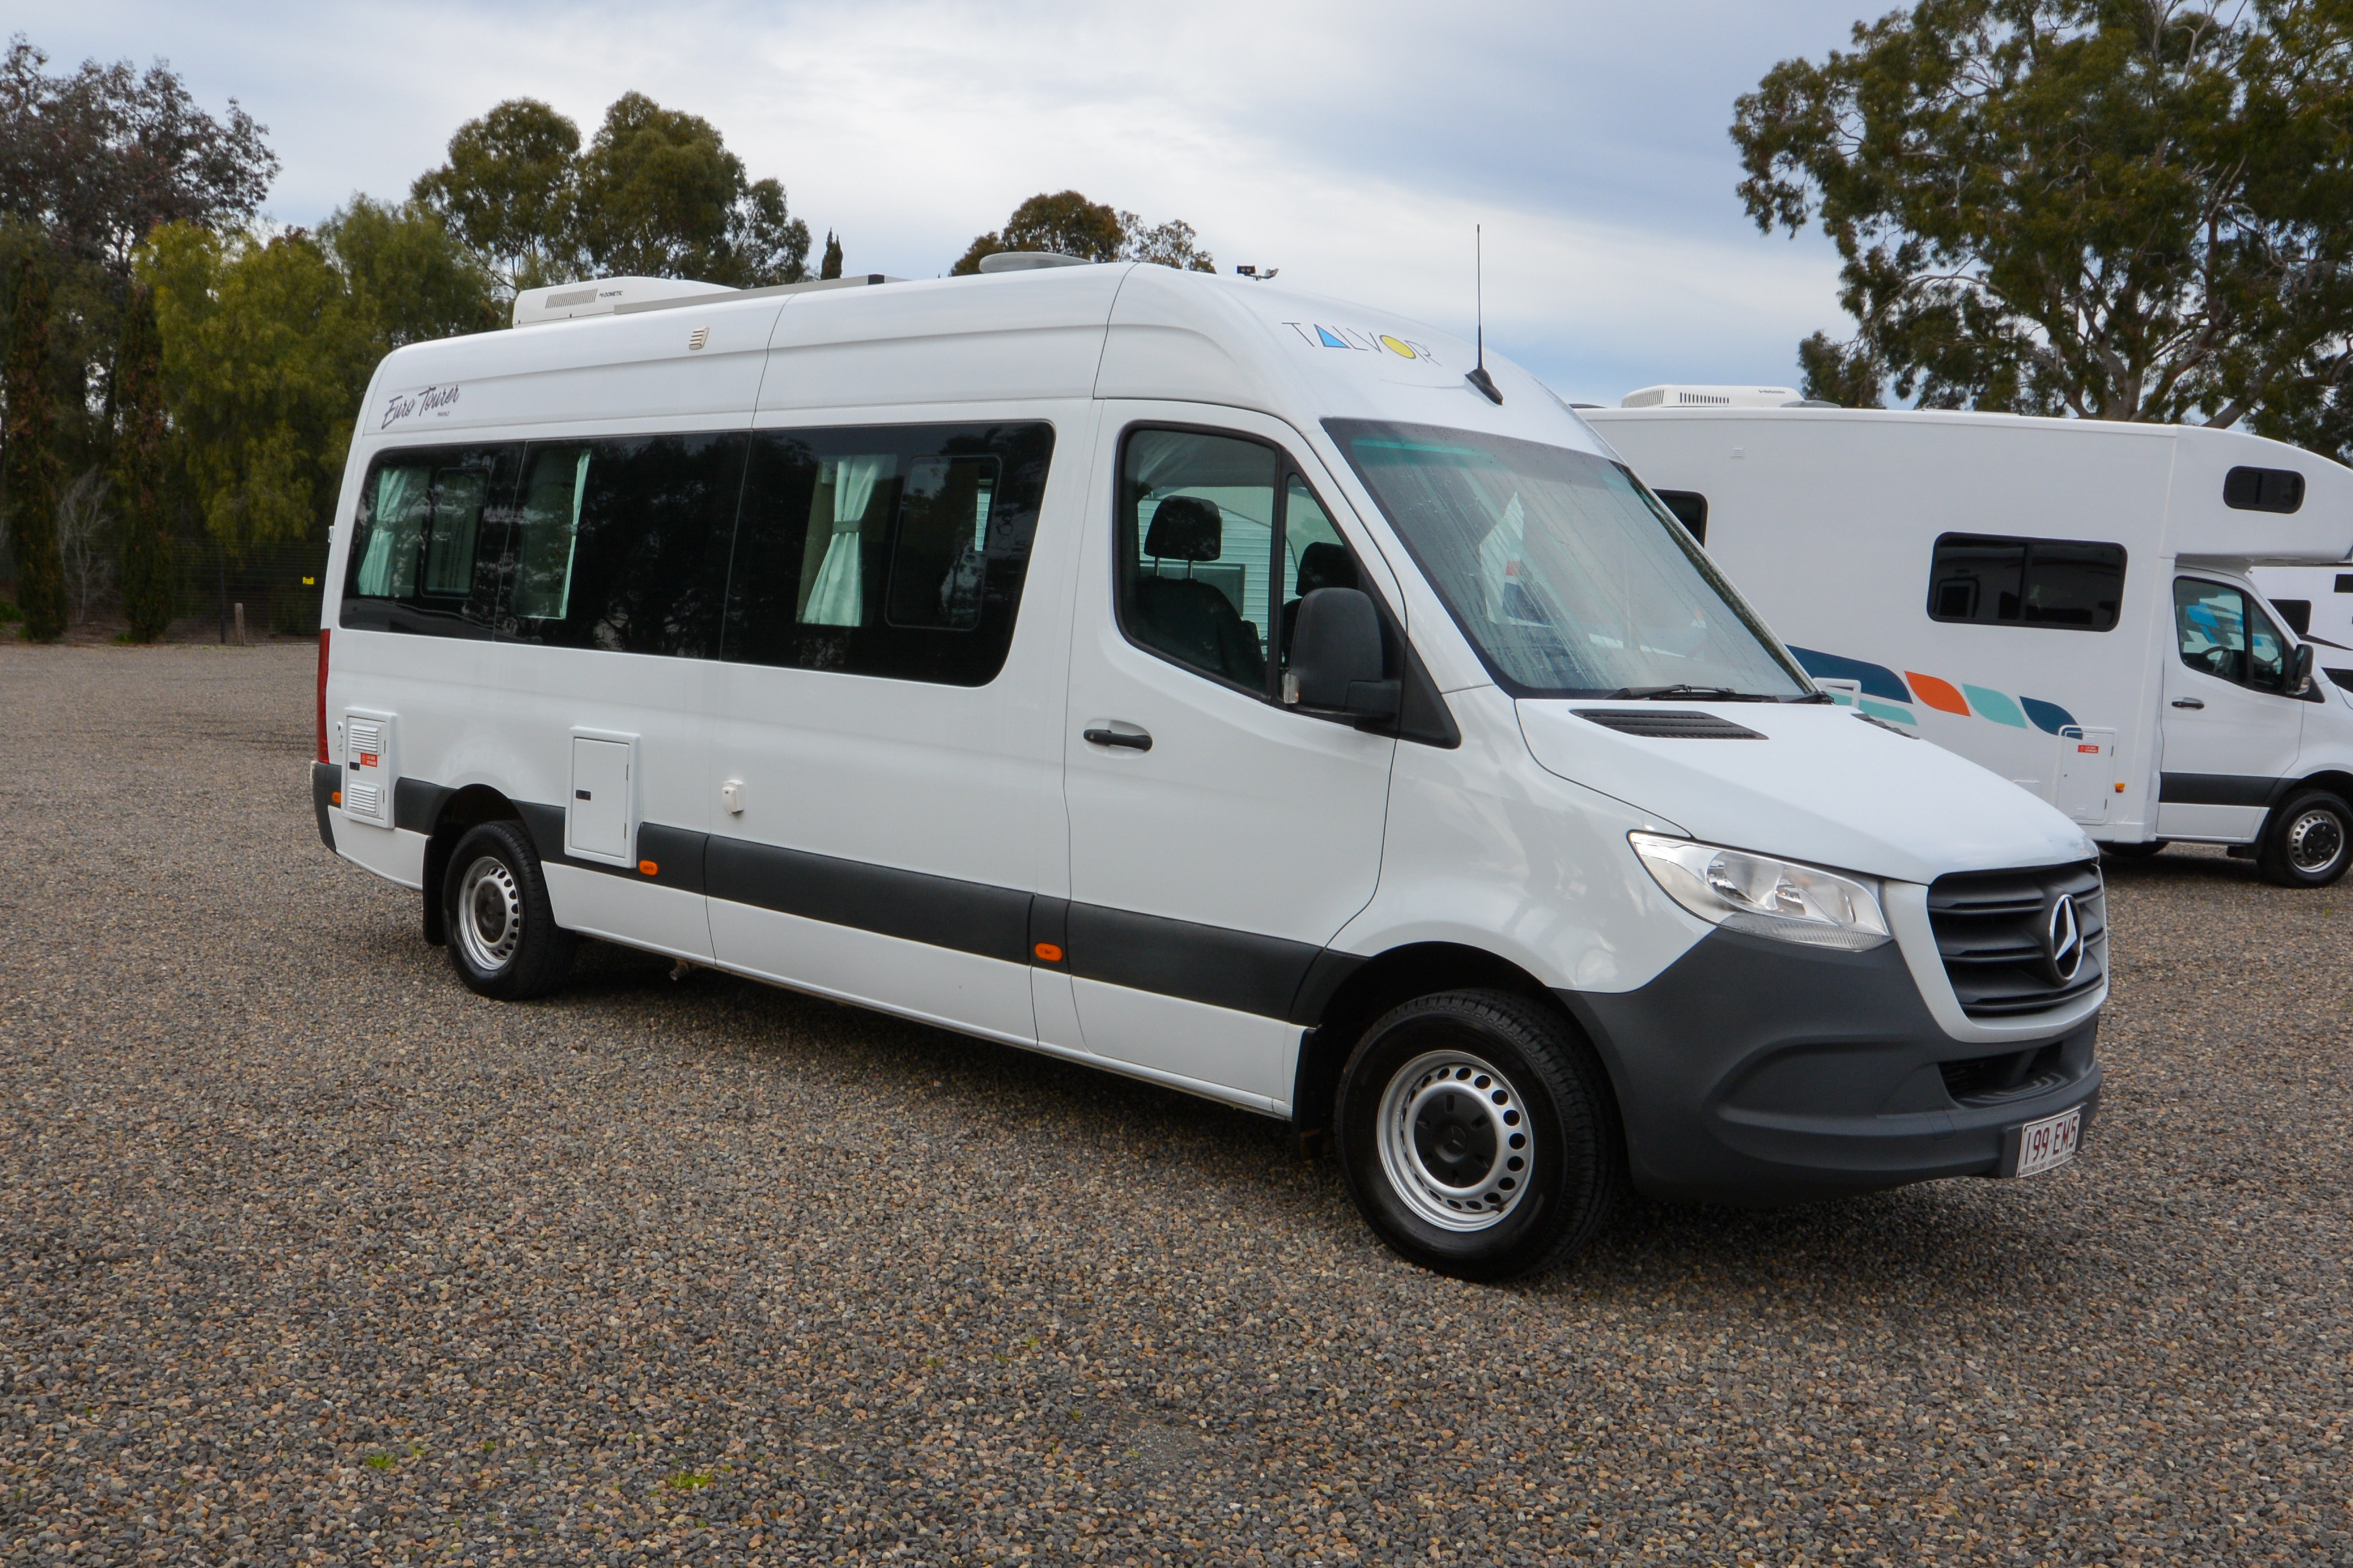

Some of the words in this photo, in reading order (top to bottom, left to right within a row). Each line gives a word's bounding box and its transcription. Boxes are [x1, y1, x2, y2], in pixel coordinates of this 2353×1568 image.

[1281, 322, 1442, 367] TALVOR
[381, 395, 416, 430] Euro
[418, 384, 460, 417] Tourer
